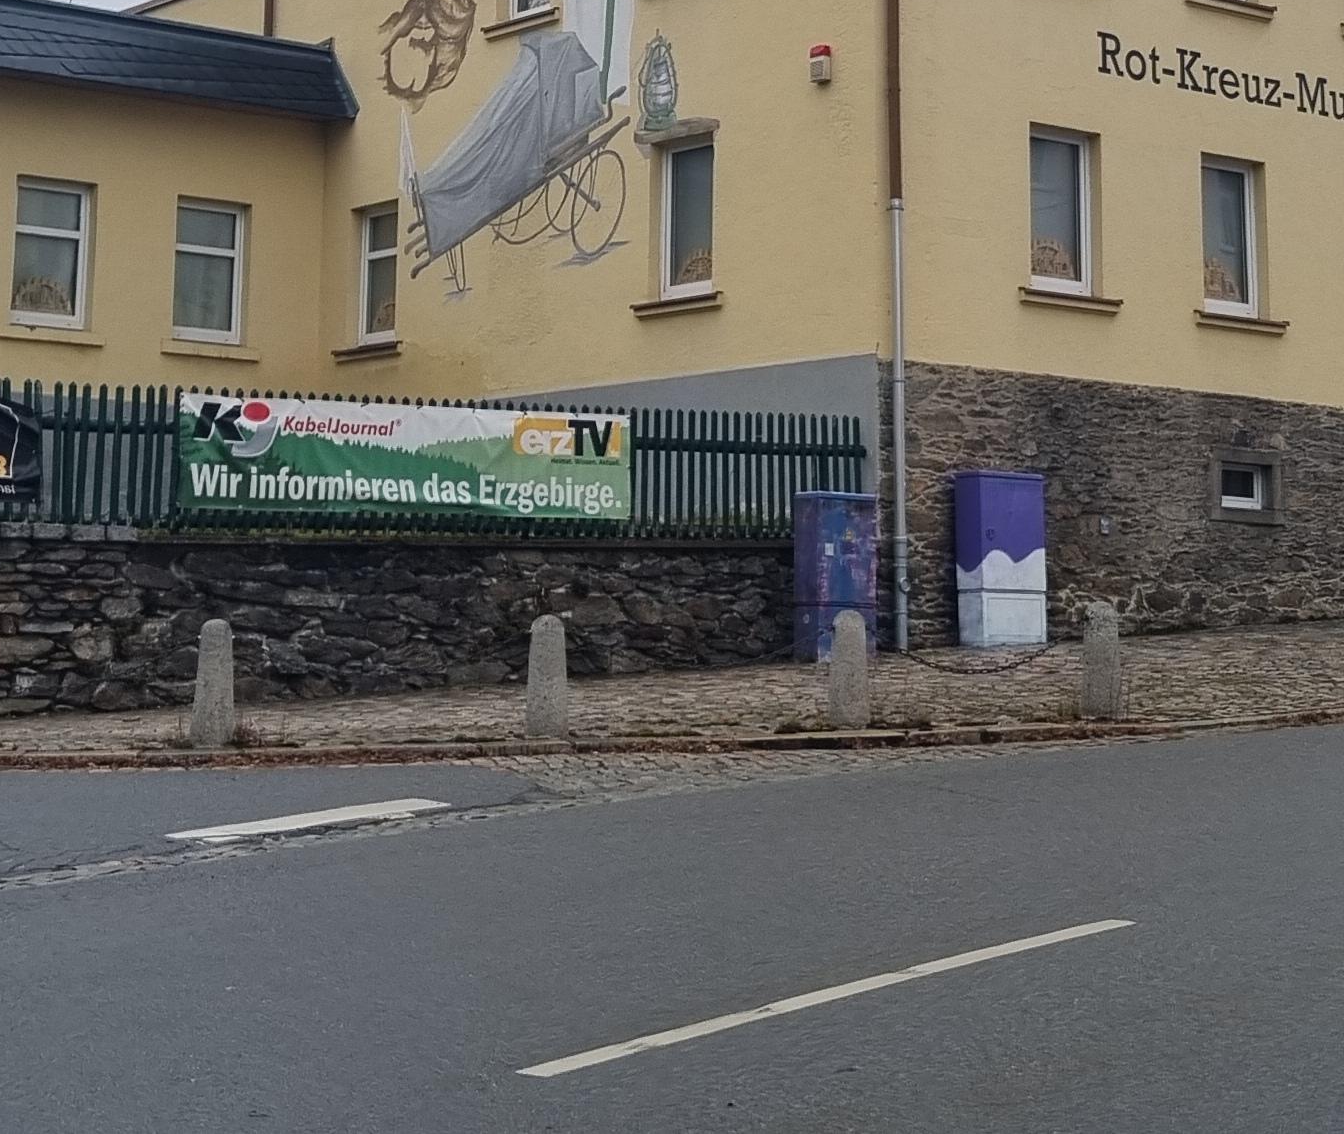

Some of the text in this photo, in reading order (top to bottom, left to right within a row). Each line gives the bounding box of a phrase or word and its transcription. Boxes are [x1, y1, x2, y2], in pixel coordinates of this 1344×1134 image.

[190, 462, 623, 516] Wir informieren das Erzgebirge.
